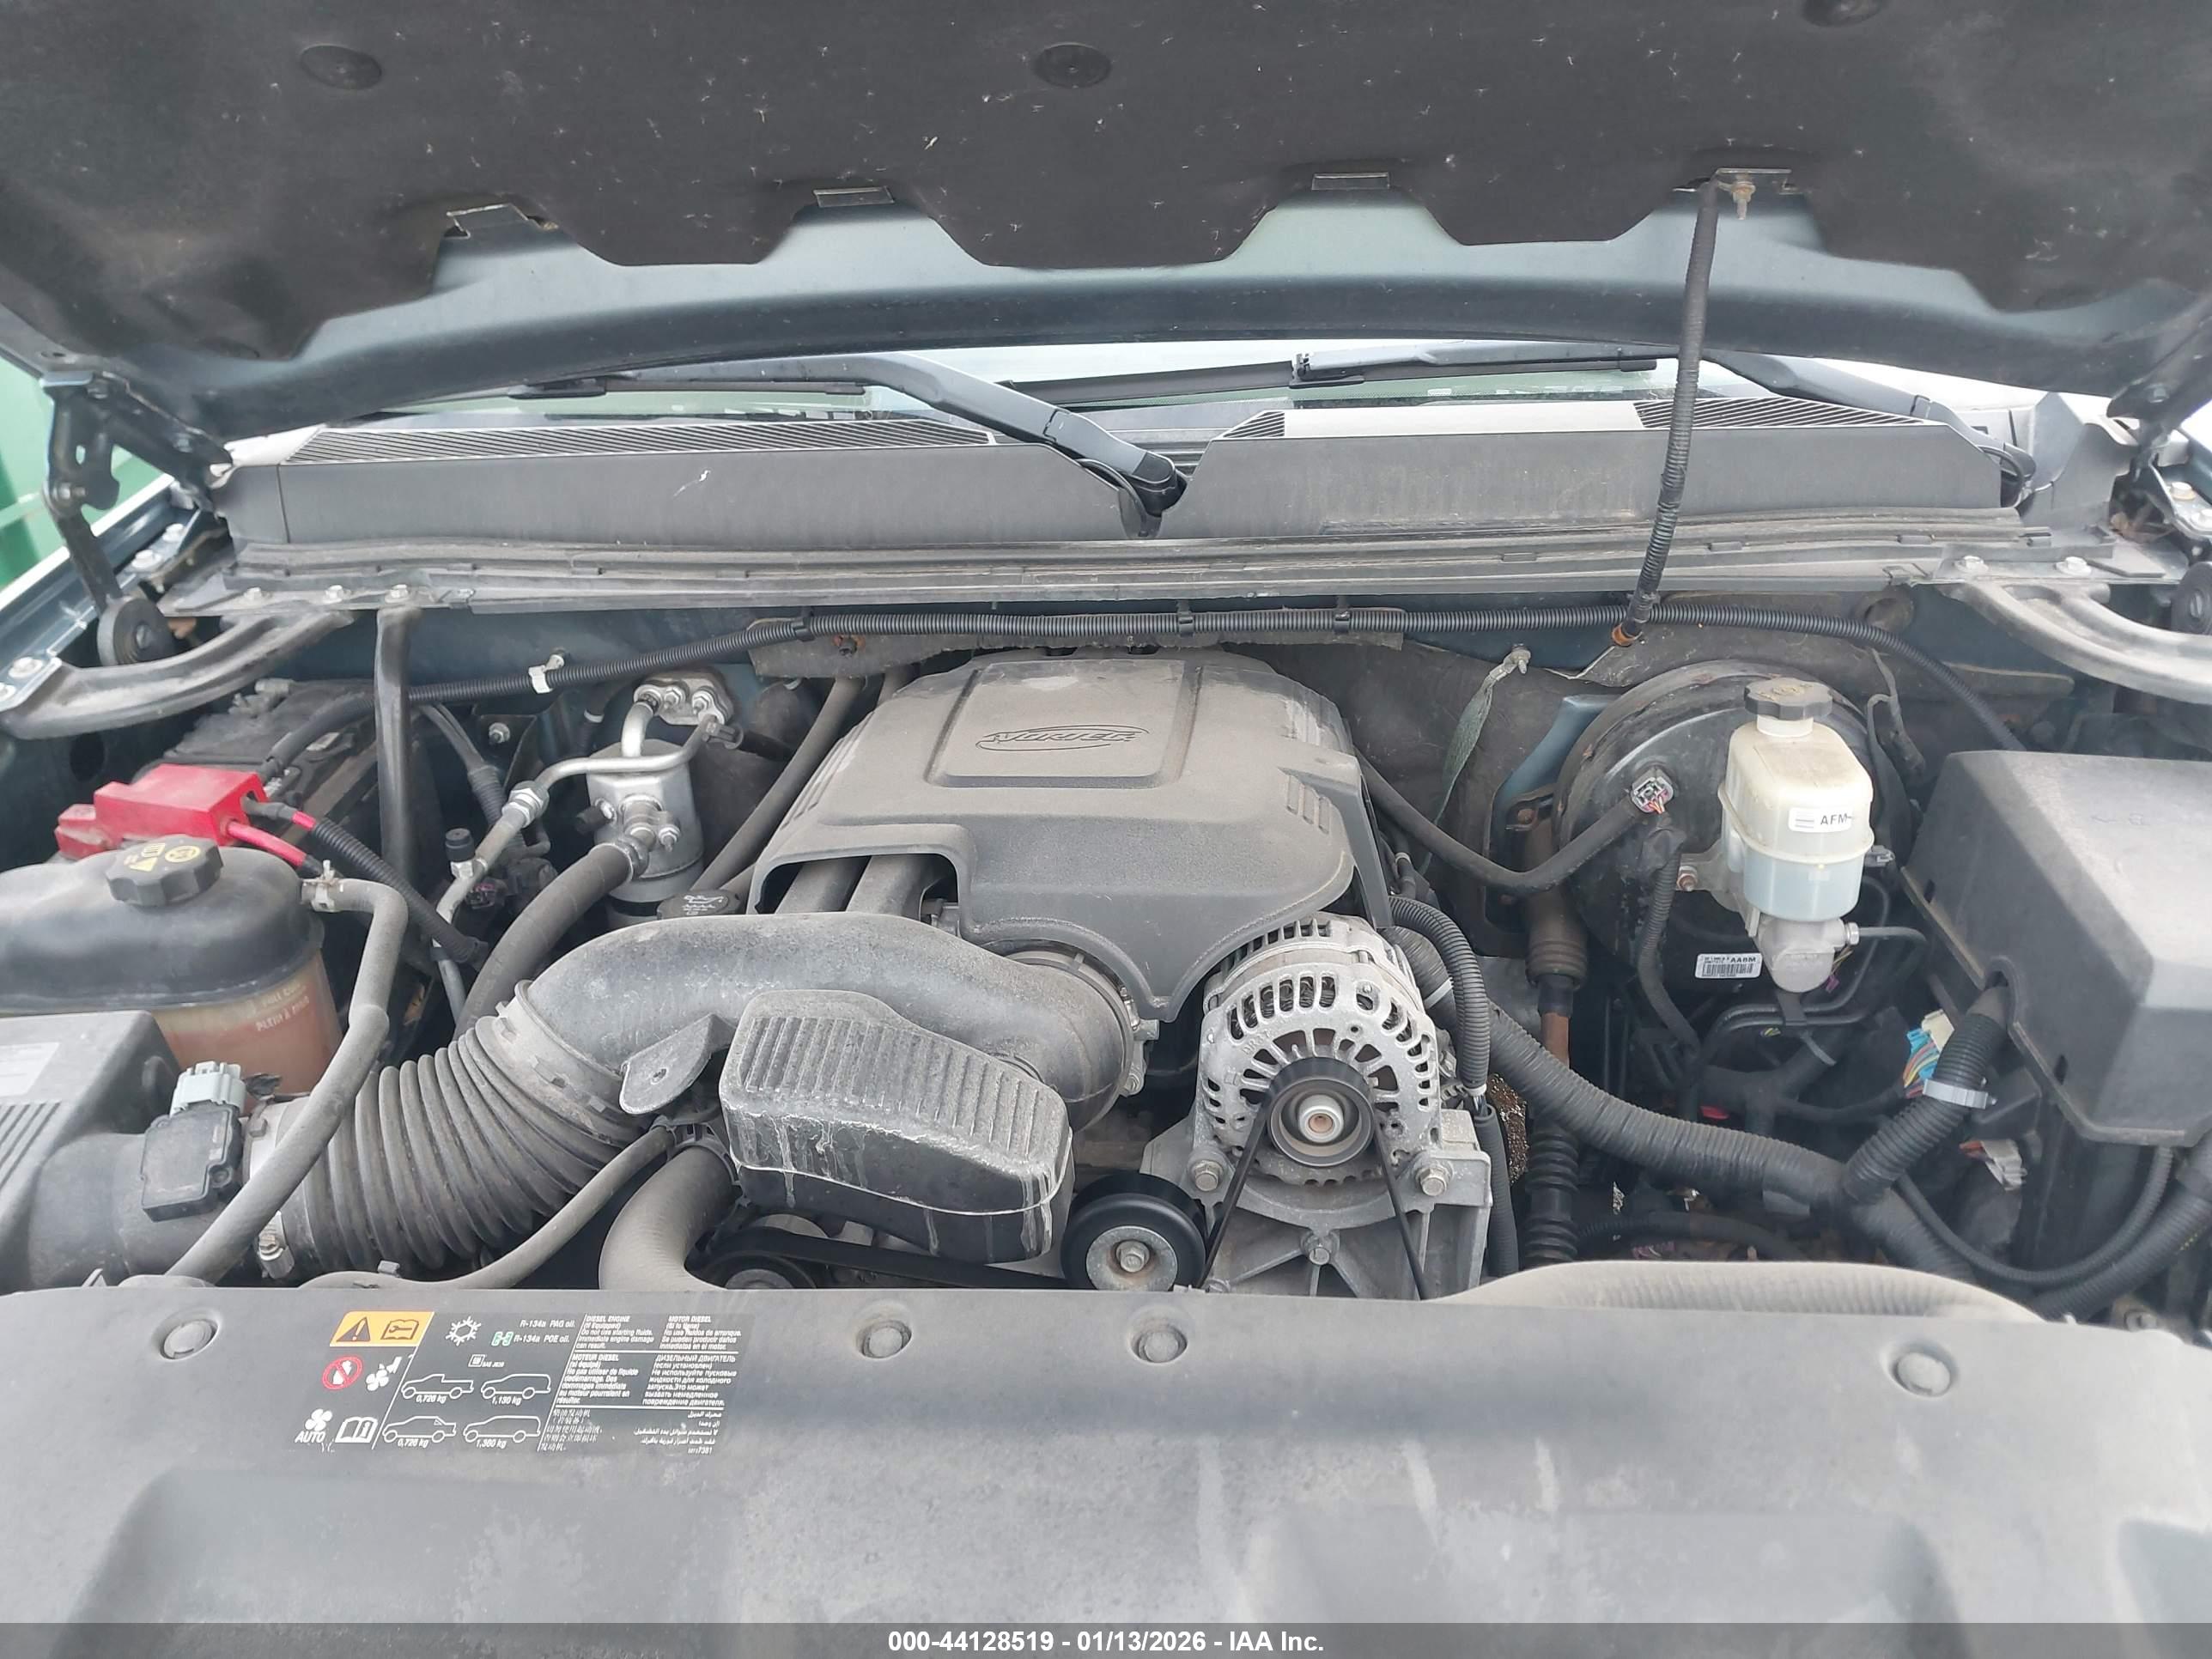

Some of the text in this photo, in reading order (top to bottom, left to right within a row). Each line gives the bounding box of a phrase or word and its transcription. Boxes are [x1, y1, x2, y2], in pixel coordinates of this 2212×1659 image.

[520, 1319, 546, 1328] R-134a
[549, 1319, 564, 1328] PAG
[586, 1315, 631, 1323] DIESEL ENGINE
[668, 1315, 712, 1323] MOTOR DIESEL
[514, 1334, 540, 1343] R-134a
[544, 1334, 559, 1343] POE
[572, 1353, 619, 1362] MOTEUR DIESEL
[655, 1353, 737, 1364] ДИЗЕЛЬНЫЙ ДВИГАТЕЛЬ
[661, 1369, 703, 1378] используйте
[437, 1395, 447, 1404] kg
[512, 1396, 523, 1407] kg
[295, 1431, 325, 1443] AUTO
[418, 1438, 429, 1449] kg
[496, 1439, 507, 1449] kg
